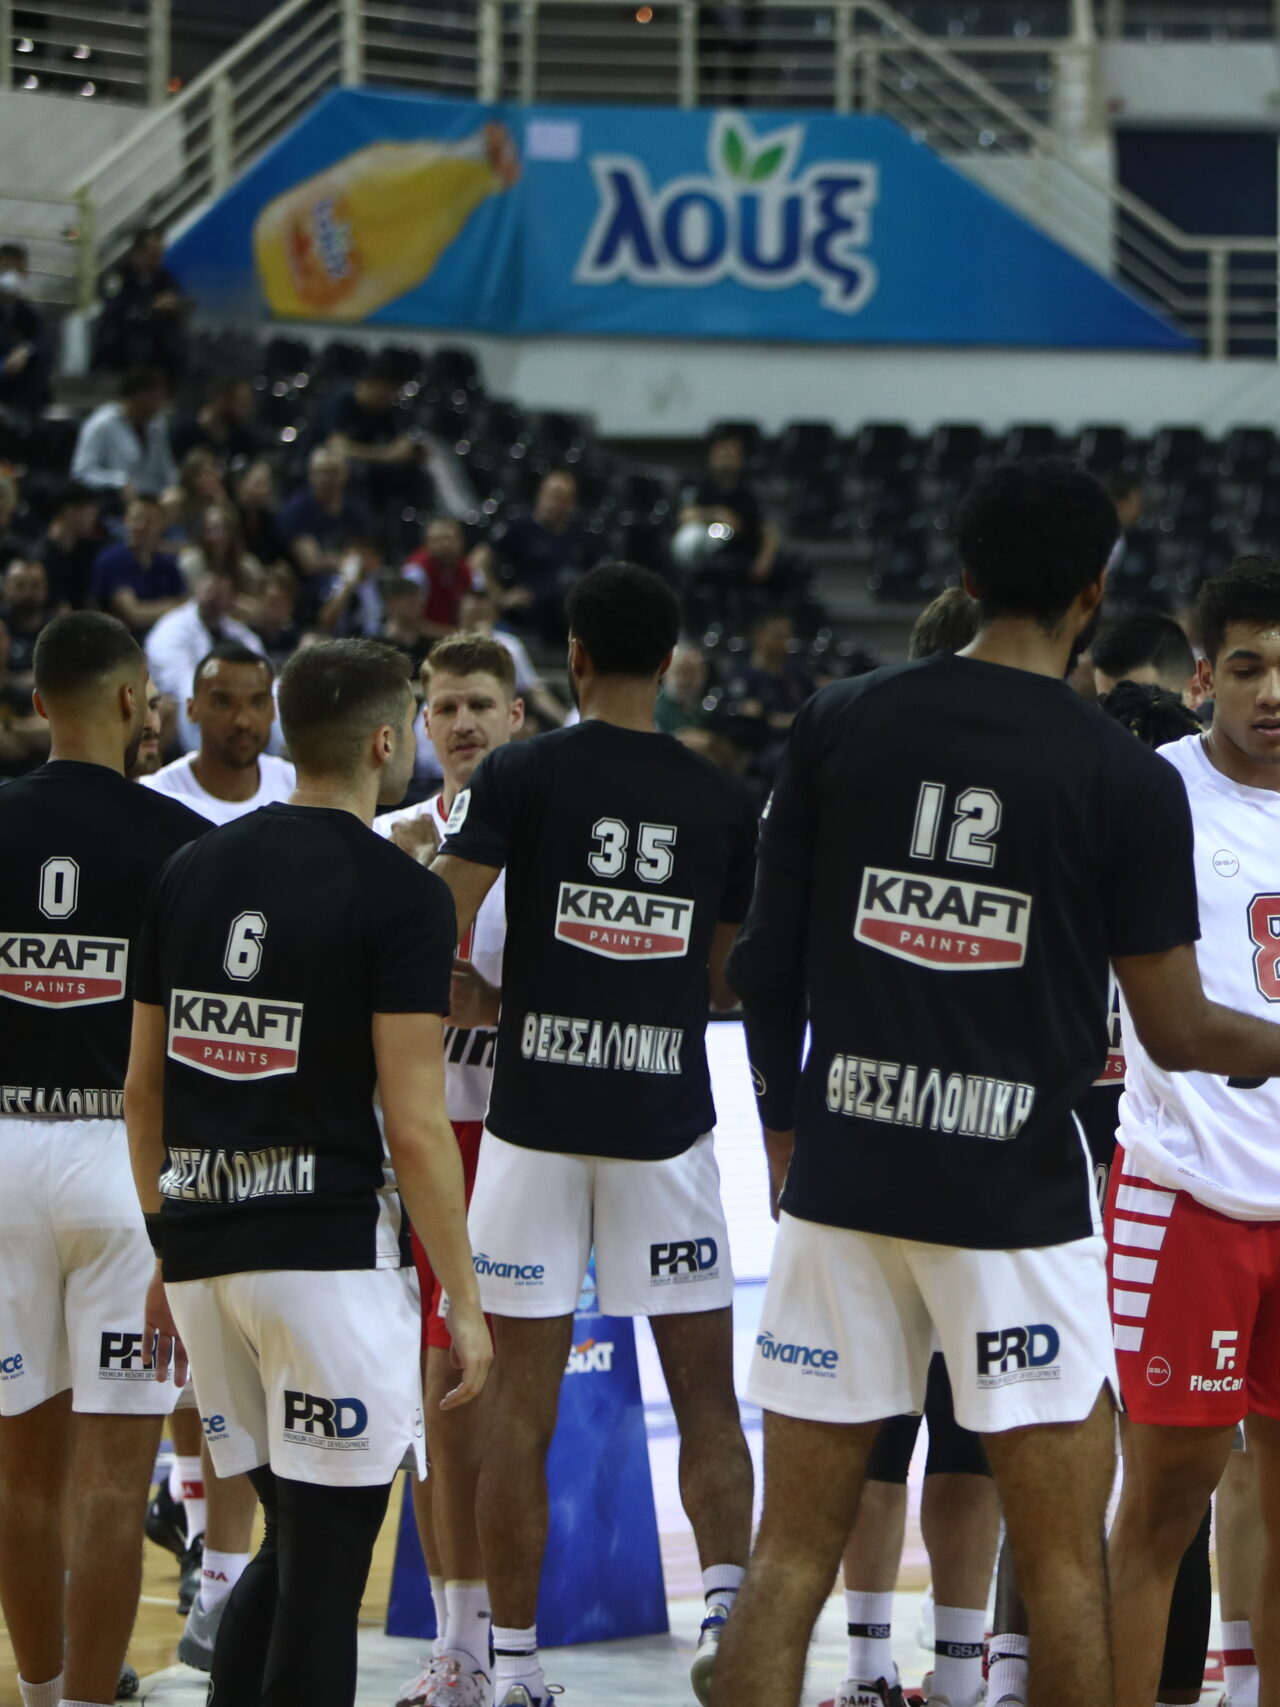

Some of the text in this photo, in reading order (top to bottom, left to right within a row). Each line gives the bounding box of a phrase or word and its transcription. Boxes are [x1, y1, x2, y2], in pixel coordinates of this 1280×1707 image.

[910, 781, 1001, 868] 12
[588, 816, 678, 884] 35
[39, 856, 80, 920] 0
[863, 873, 1028, 934] KRAFT
[560, 887, 690, 931] KRAFT
[223, 911, 267, 982] 6
[589, 930, 653, 949] PAINTS
[900, 930, 981, 957] PAINTS
[24, 981, 87, 995] PAINTS
[174, 994, 302, 1042] KRAFT
[203, 1046, 269, 1066] PAINTS
[475, 1258, 545, 1280] avance
[650, 1237, 718, 1276] PRD
[761, 1339, 839, 1370] avance
[976, 1324, 1060, 1376] PRD
[1189, 1375, 1244, 1392] FlexCar
[284, 1390, 368, 1438] PRD
[867, 1625, 891, 1639] GS
